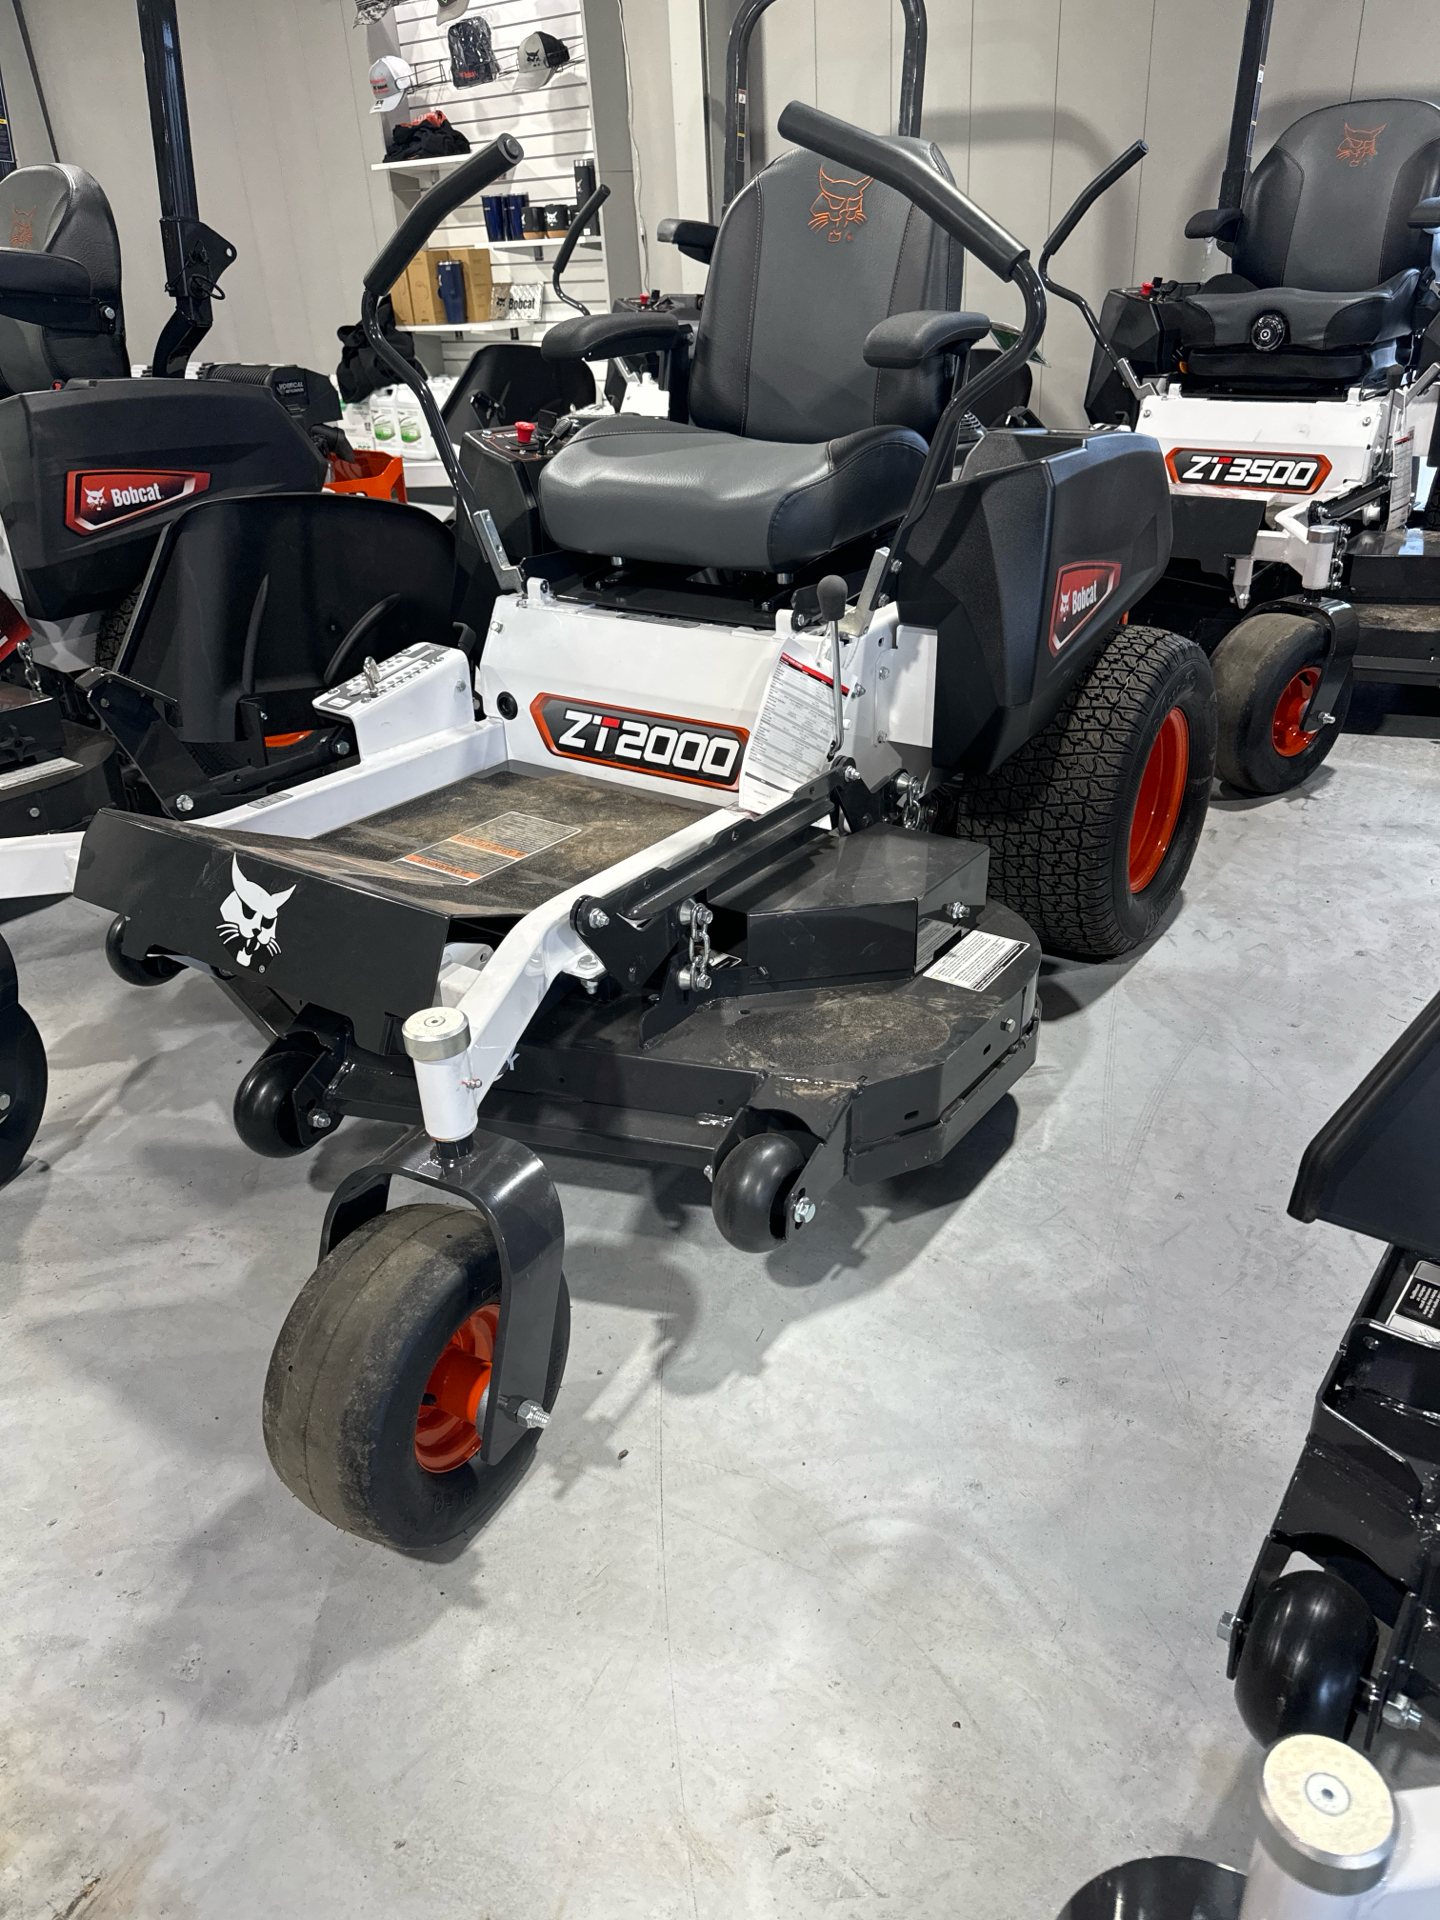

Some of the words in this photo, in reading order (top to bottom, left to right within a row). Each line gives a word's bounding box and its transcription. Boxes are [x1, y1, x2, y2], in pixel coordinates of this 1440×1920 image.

[508, 297, 535, 310] Bobcat
[1182, 455, 1318, 487] ZT3500
[110, 482, 162, 507] Bobcat
[1071, 579, 1097, 615] Bobcat
[558, 709, 740, 777] ZT2000
